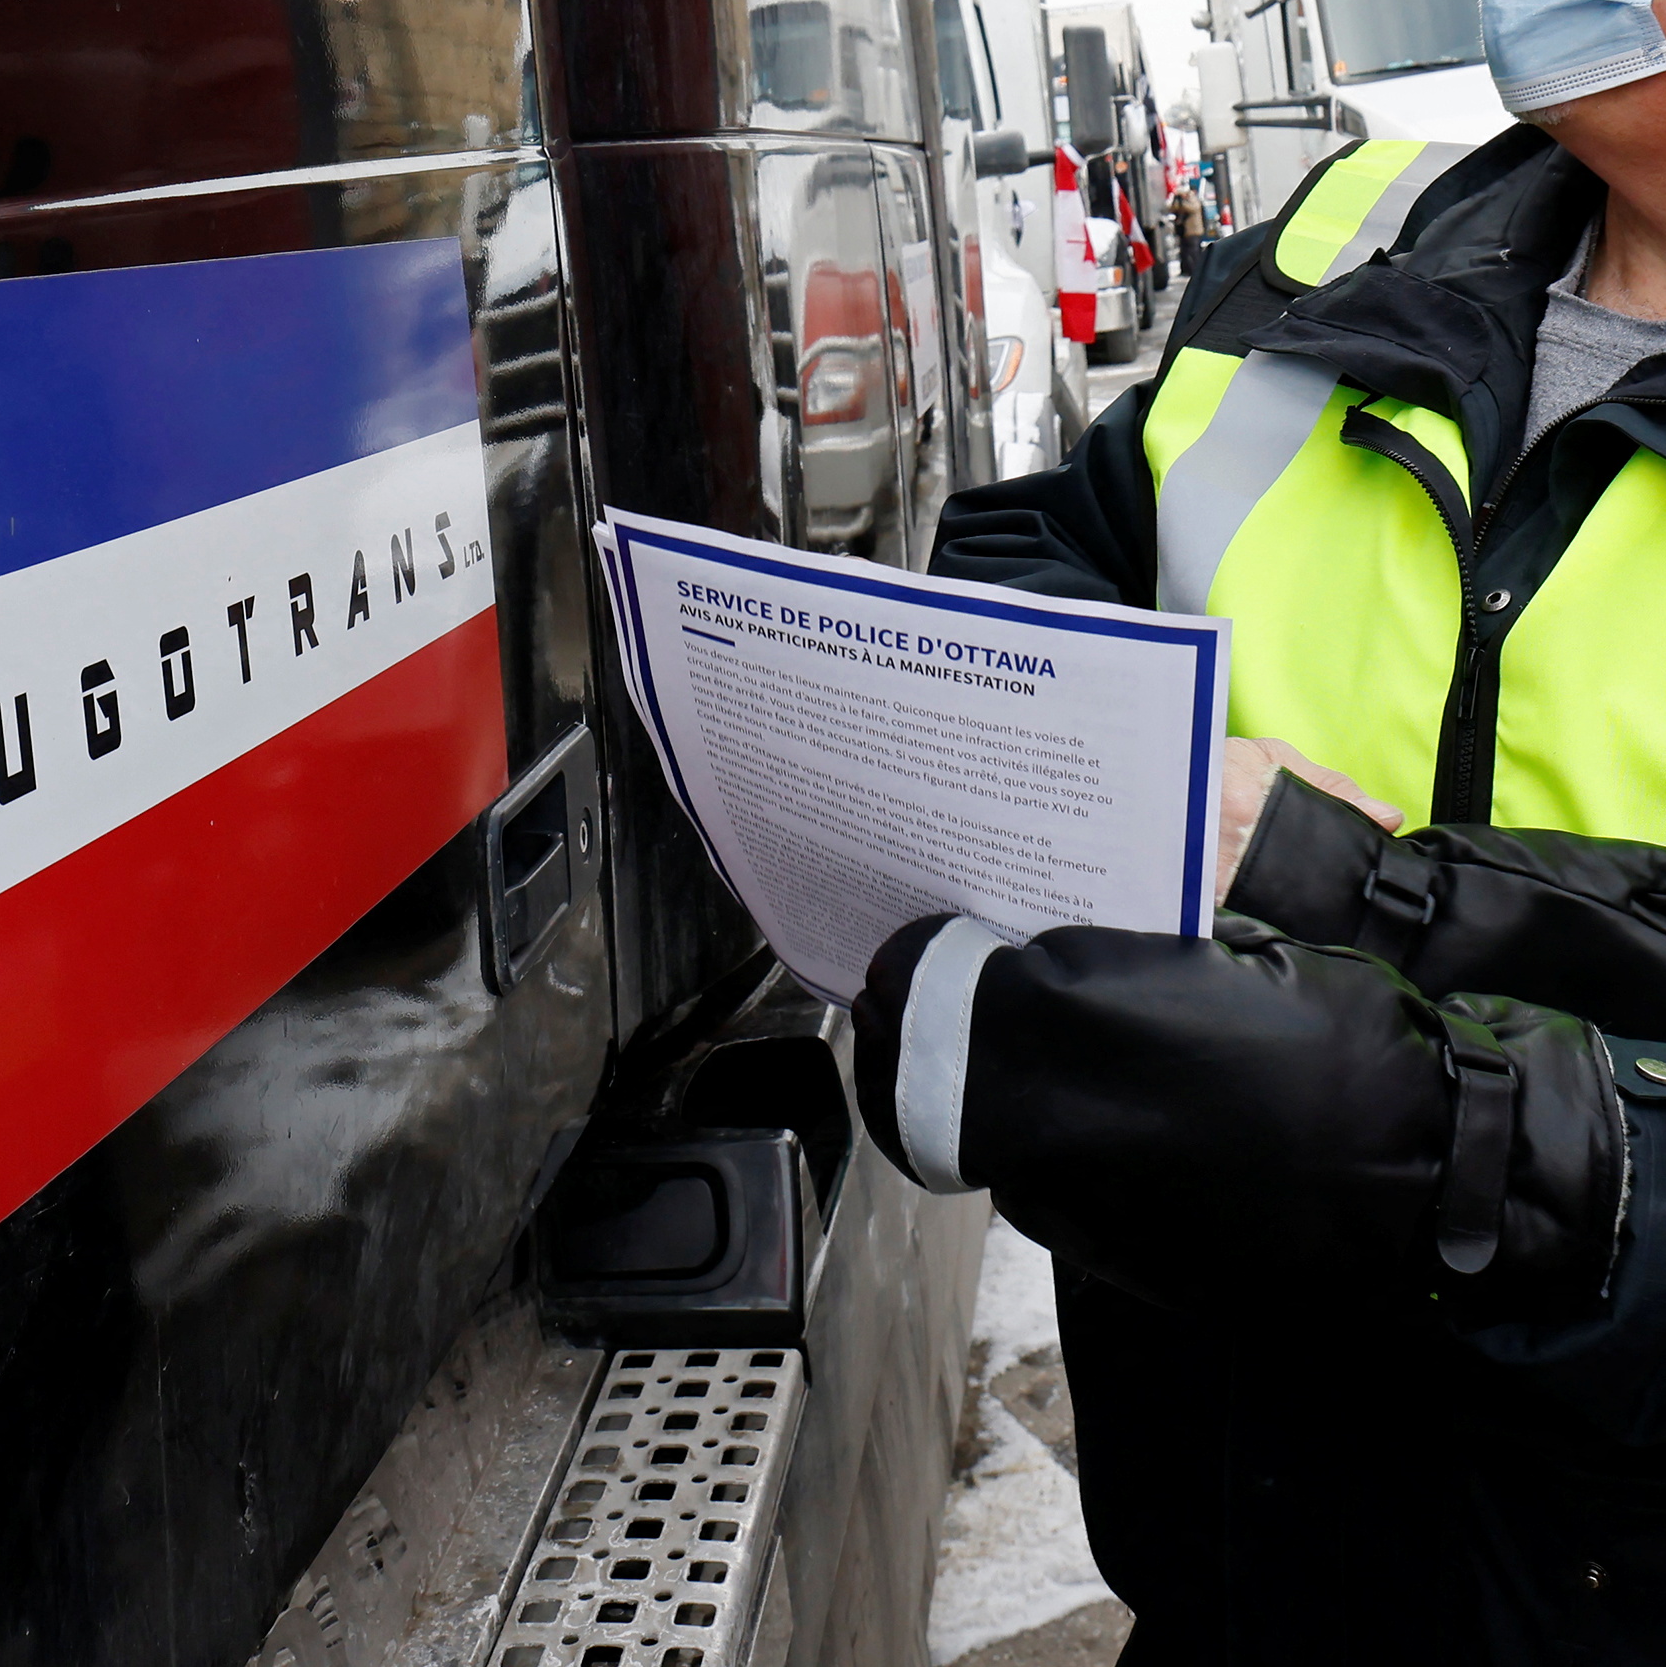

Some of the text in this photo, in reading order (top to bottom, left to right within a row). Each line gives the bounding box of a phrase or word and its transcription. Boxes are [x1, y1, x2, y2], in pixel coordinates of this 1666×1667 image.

[463, 540, 485, 570] LTD.
[677, 580, 1055, 678] SERVICE DE POLICE D'OTTAWA
[679, 603, 1034, 694] AVIS AUX PARTICIPANTS À LA MANIFESTATION
[684, 639, 1084, 748] Vous devez quitter les lieux maintenant. Quiconque bloquant les voies de
[687, 655, 1100, 768] circulation, ou aidant d'autres à le faire, commet une infraction criminelle et
[689, 670, 1099, 786] peut être arrêté. Vous devez cesser immédiatement vos activités illégales ou
[769, 725, 1088, 818] caution dépendra de facteurs figurant dans la partie XVI du
[775, 710, 1112, 805] face à des accusations. Si vous êtes arrêté, que vous soyez ou
[884, 791, 1051, 848] l'emploi, de la jouissance et de
[941, 827, 1107, 876] responsables de la fermeture
[956, 843, 1054, 881] du Code criminel.
[964, 877, 1093, 926] franchir la frontière des
[997, 874, 1093, 909] illégales liées à la
